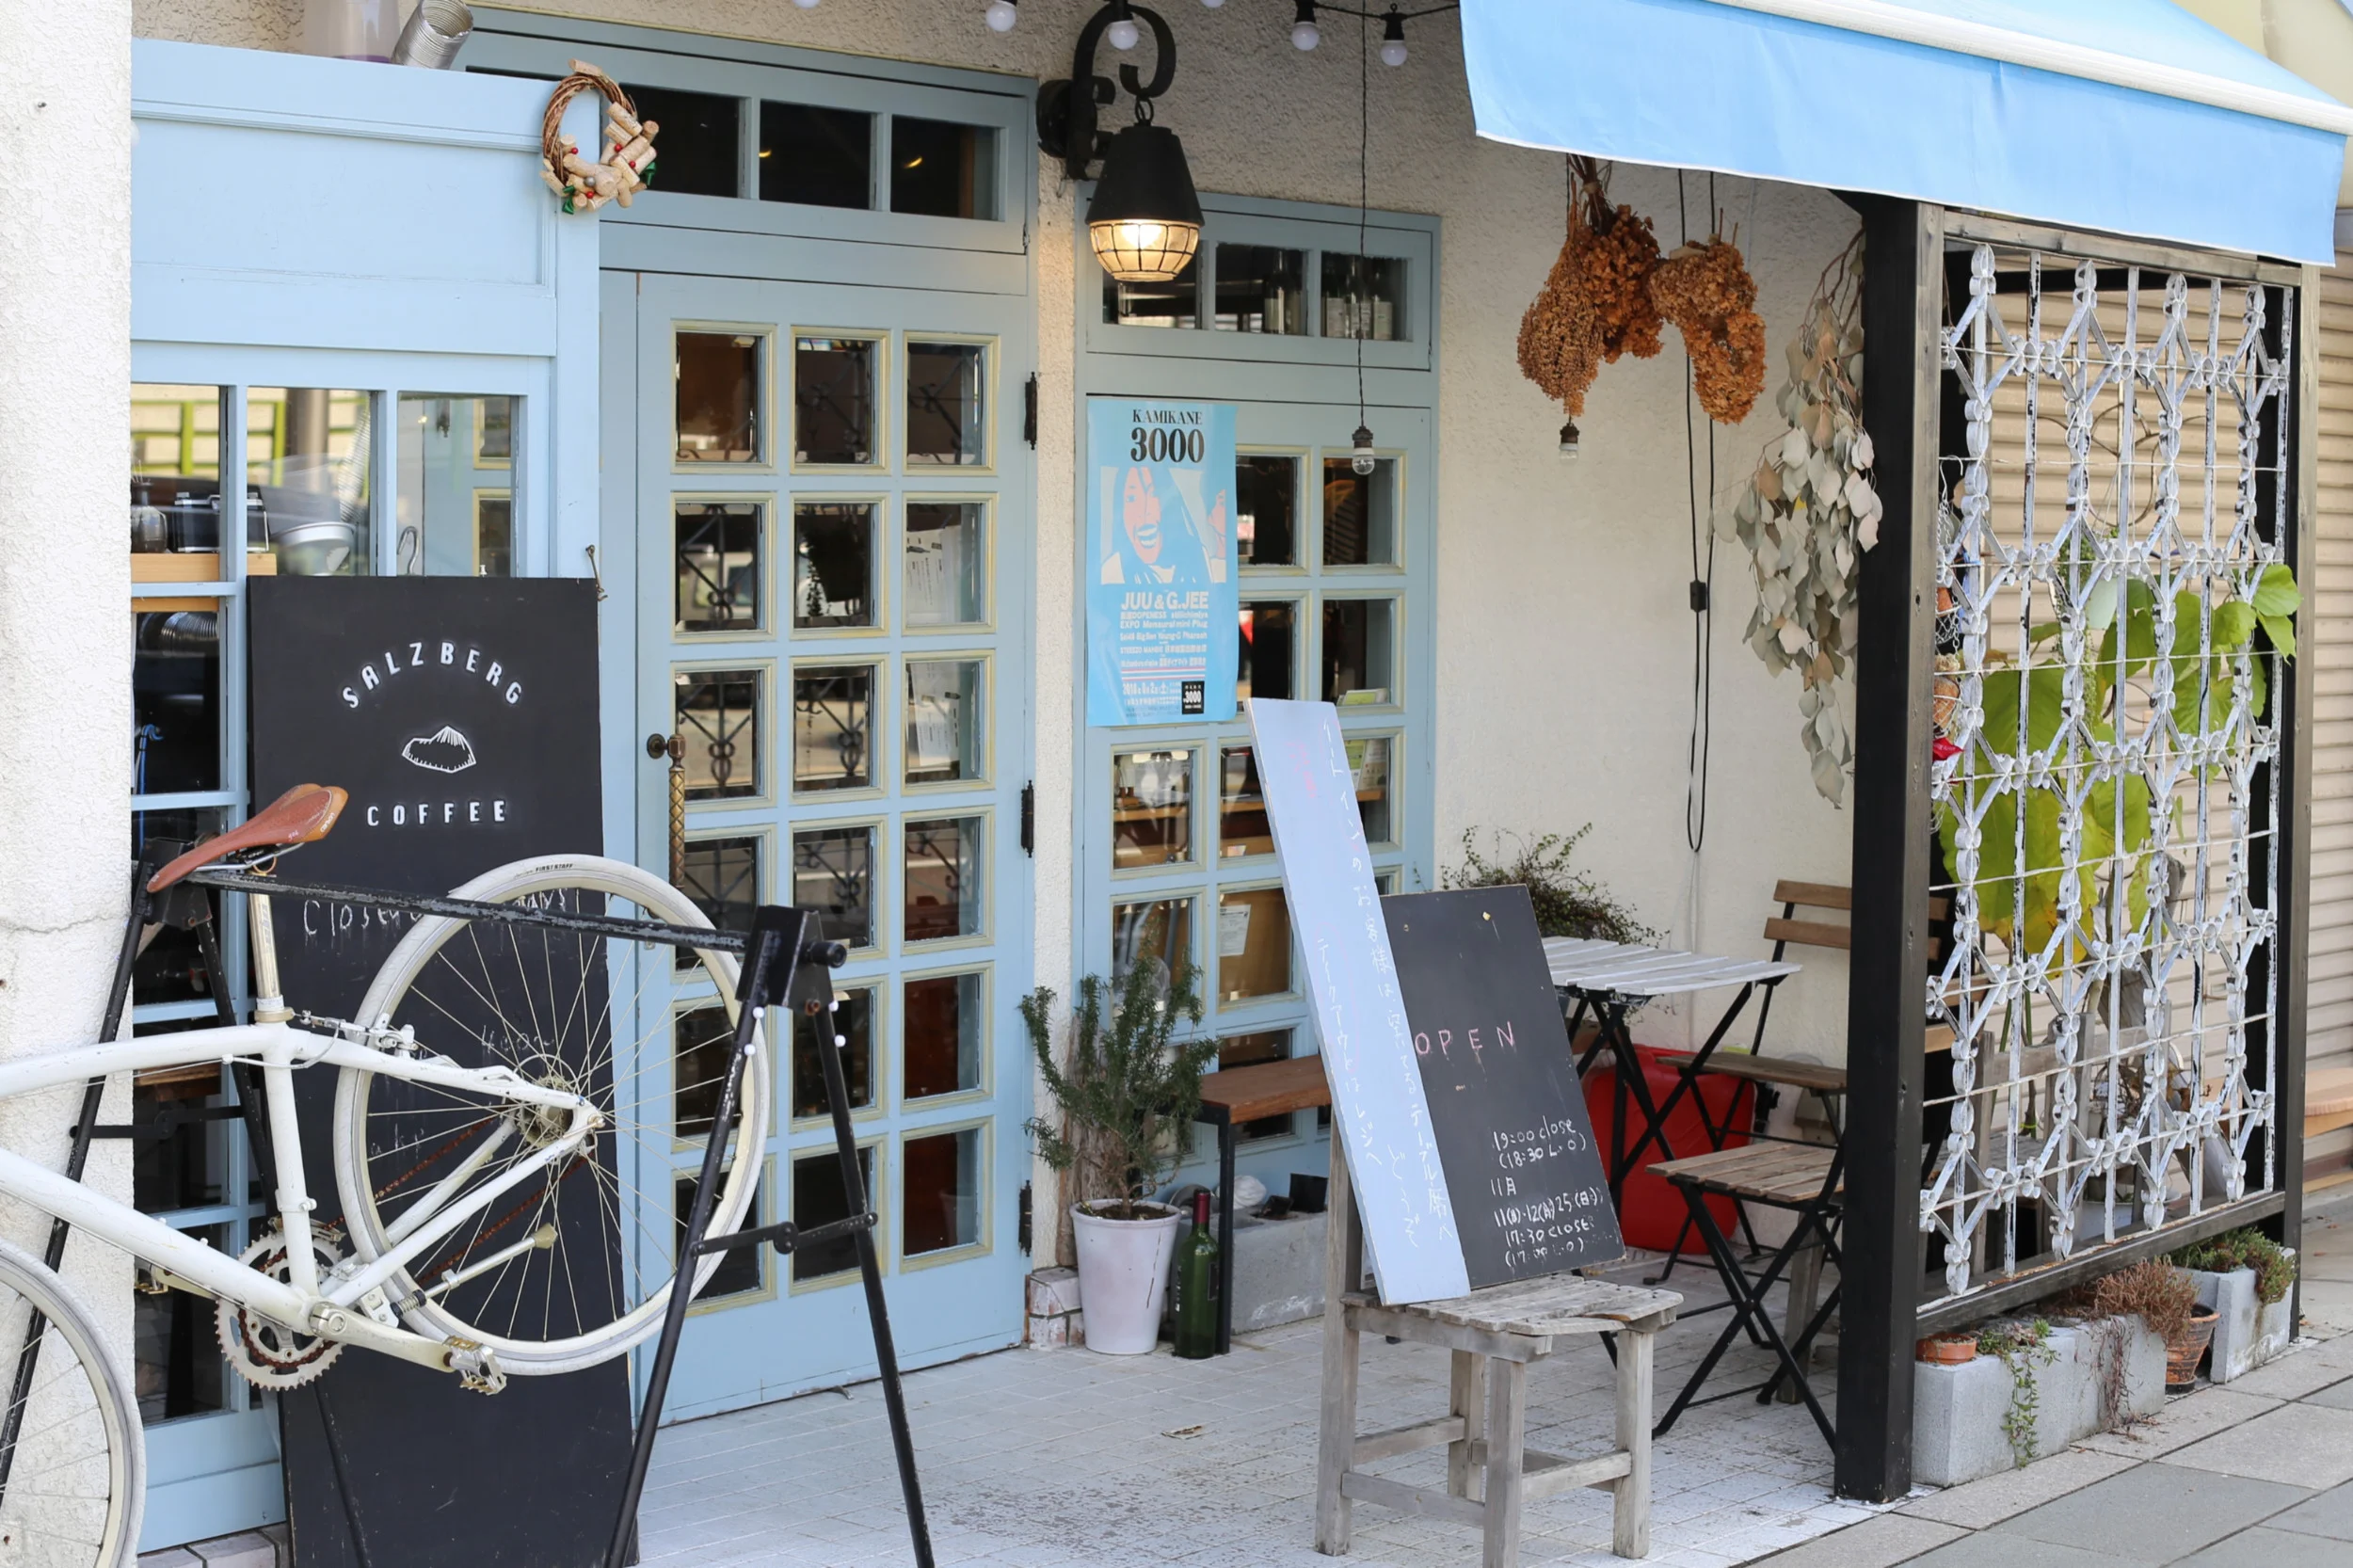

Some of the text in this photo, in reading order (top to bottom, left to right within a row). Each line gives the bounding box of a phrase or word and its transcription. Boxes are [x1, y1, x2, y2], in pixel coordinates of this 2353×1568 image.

[1132, 408, 1204, 424] KAMIKANE
[1130, 427, 1205, 463] 3000
[1121, 591, 1209, 610] JUU & G.JEE
[1120, 620, 1141, 630] EXPO
[343, 641, 522, 709] SALZBERG
[366, 800, 506, 827] COFFEE
[303, 899, 400, 936] Close
[1414, 1020, 1517, 1057] OPEN
[1493, 1114, 1577, 1151] 19:00 close
[1505, 1228, 1545, 1248] 17:30
